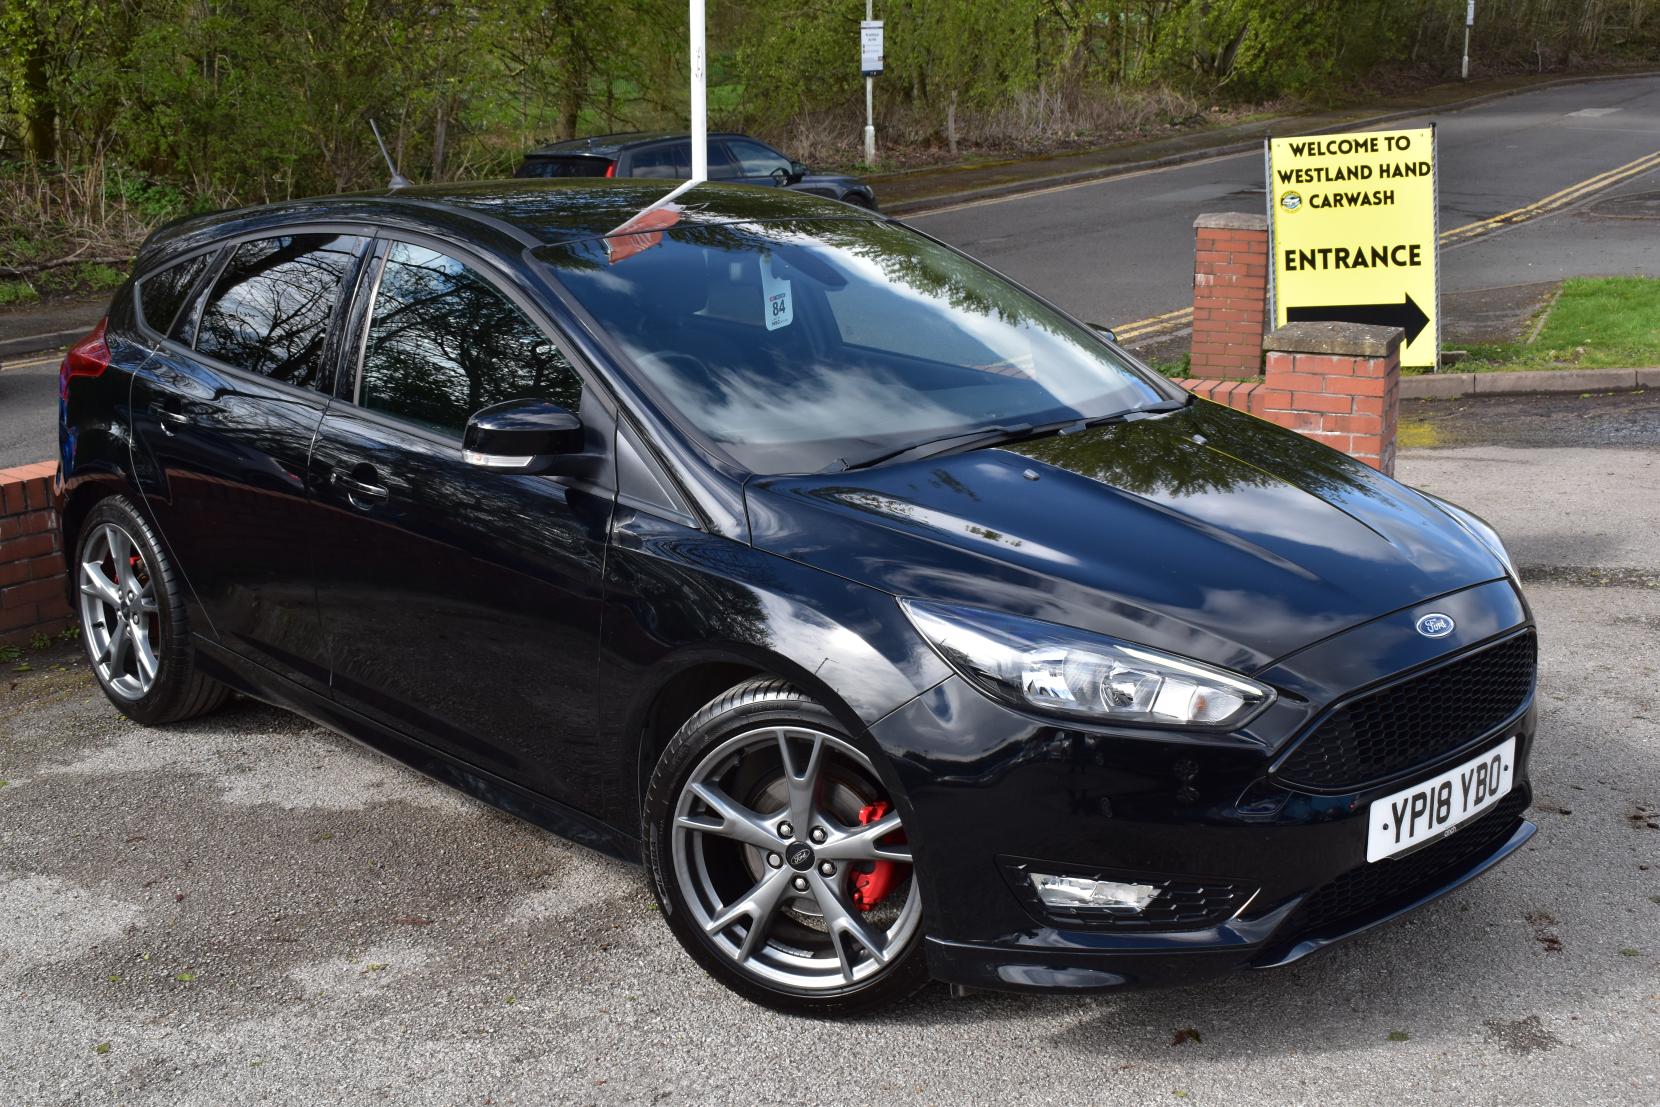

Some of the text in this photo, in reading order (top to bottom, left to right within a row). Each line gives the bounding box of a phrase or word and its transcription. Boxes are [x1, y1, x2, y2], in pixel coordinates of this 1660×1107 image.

[1289, 135, 1411, 157] WELCOME TO
[1277, 161, 1431, 184] WESTLAND HAND
[1309, 190, 1395, 209] CARWASH
[1285, 244, 1422, 271] ENTRANCE
[773, 299, 785, 316] 84
[1424, 618, 1447, 633] Ford
[1391, 753, 1502, 844] YP18 YBO
